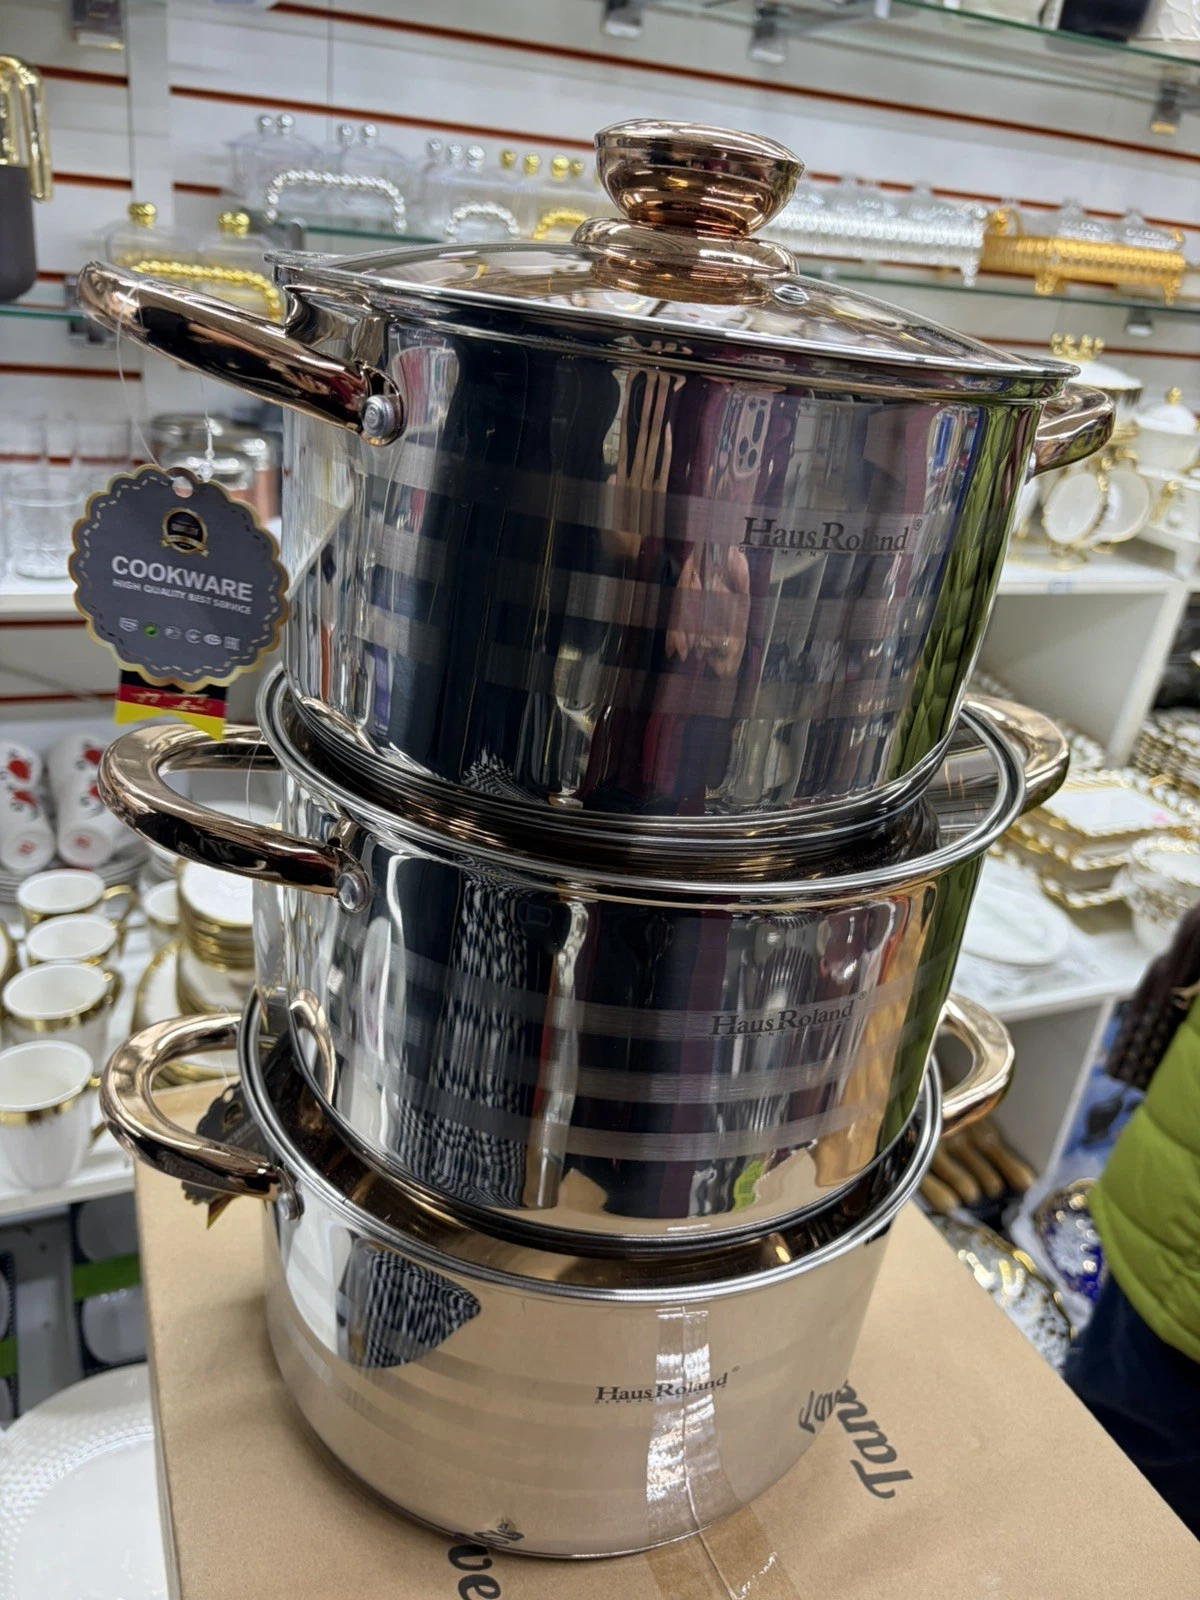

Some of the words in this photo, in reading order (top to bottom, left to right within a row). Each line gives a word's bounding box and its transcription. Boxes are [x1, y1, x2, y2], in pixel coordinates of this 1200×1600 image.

[111, 555, 253, 602] COOKWARE
[112, 578, 142, 591] HIGH
[143, 584, 187, 600] QUALITY
[187, 593, 212, 605] BEST
[212, 599, 253, 615] SERVICE
